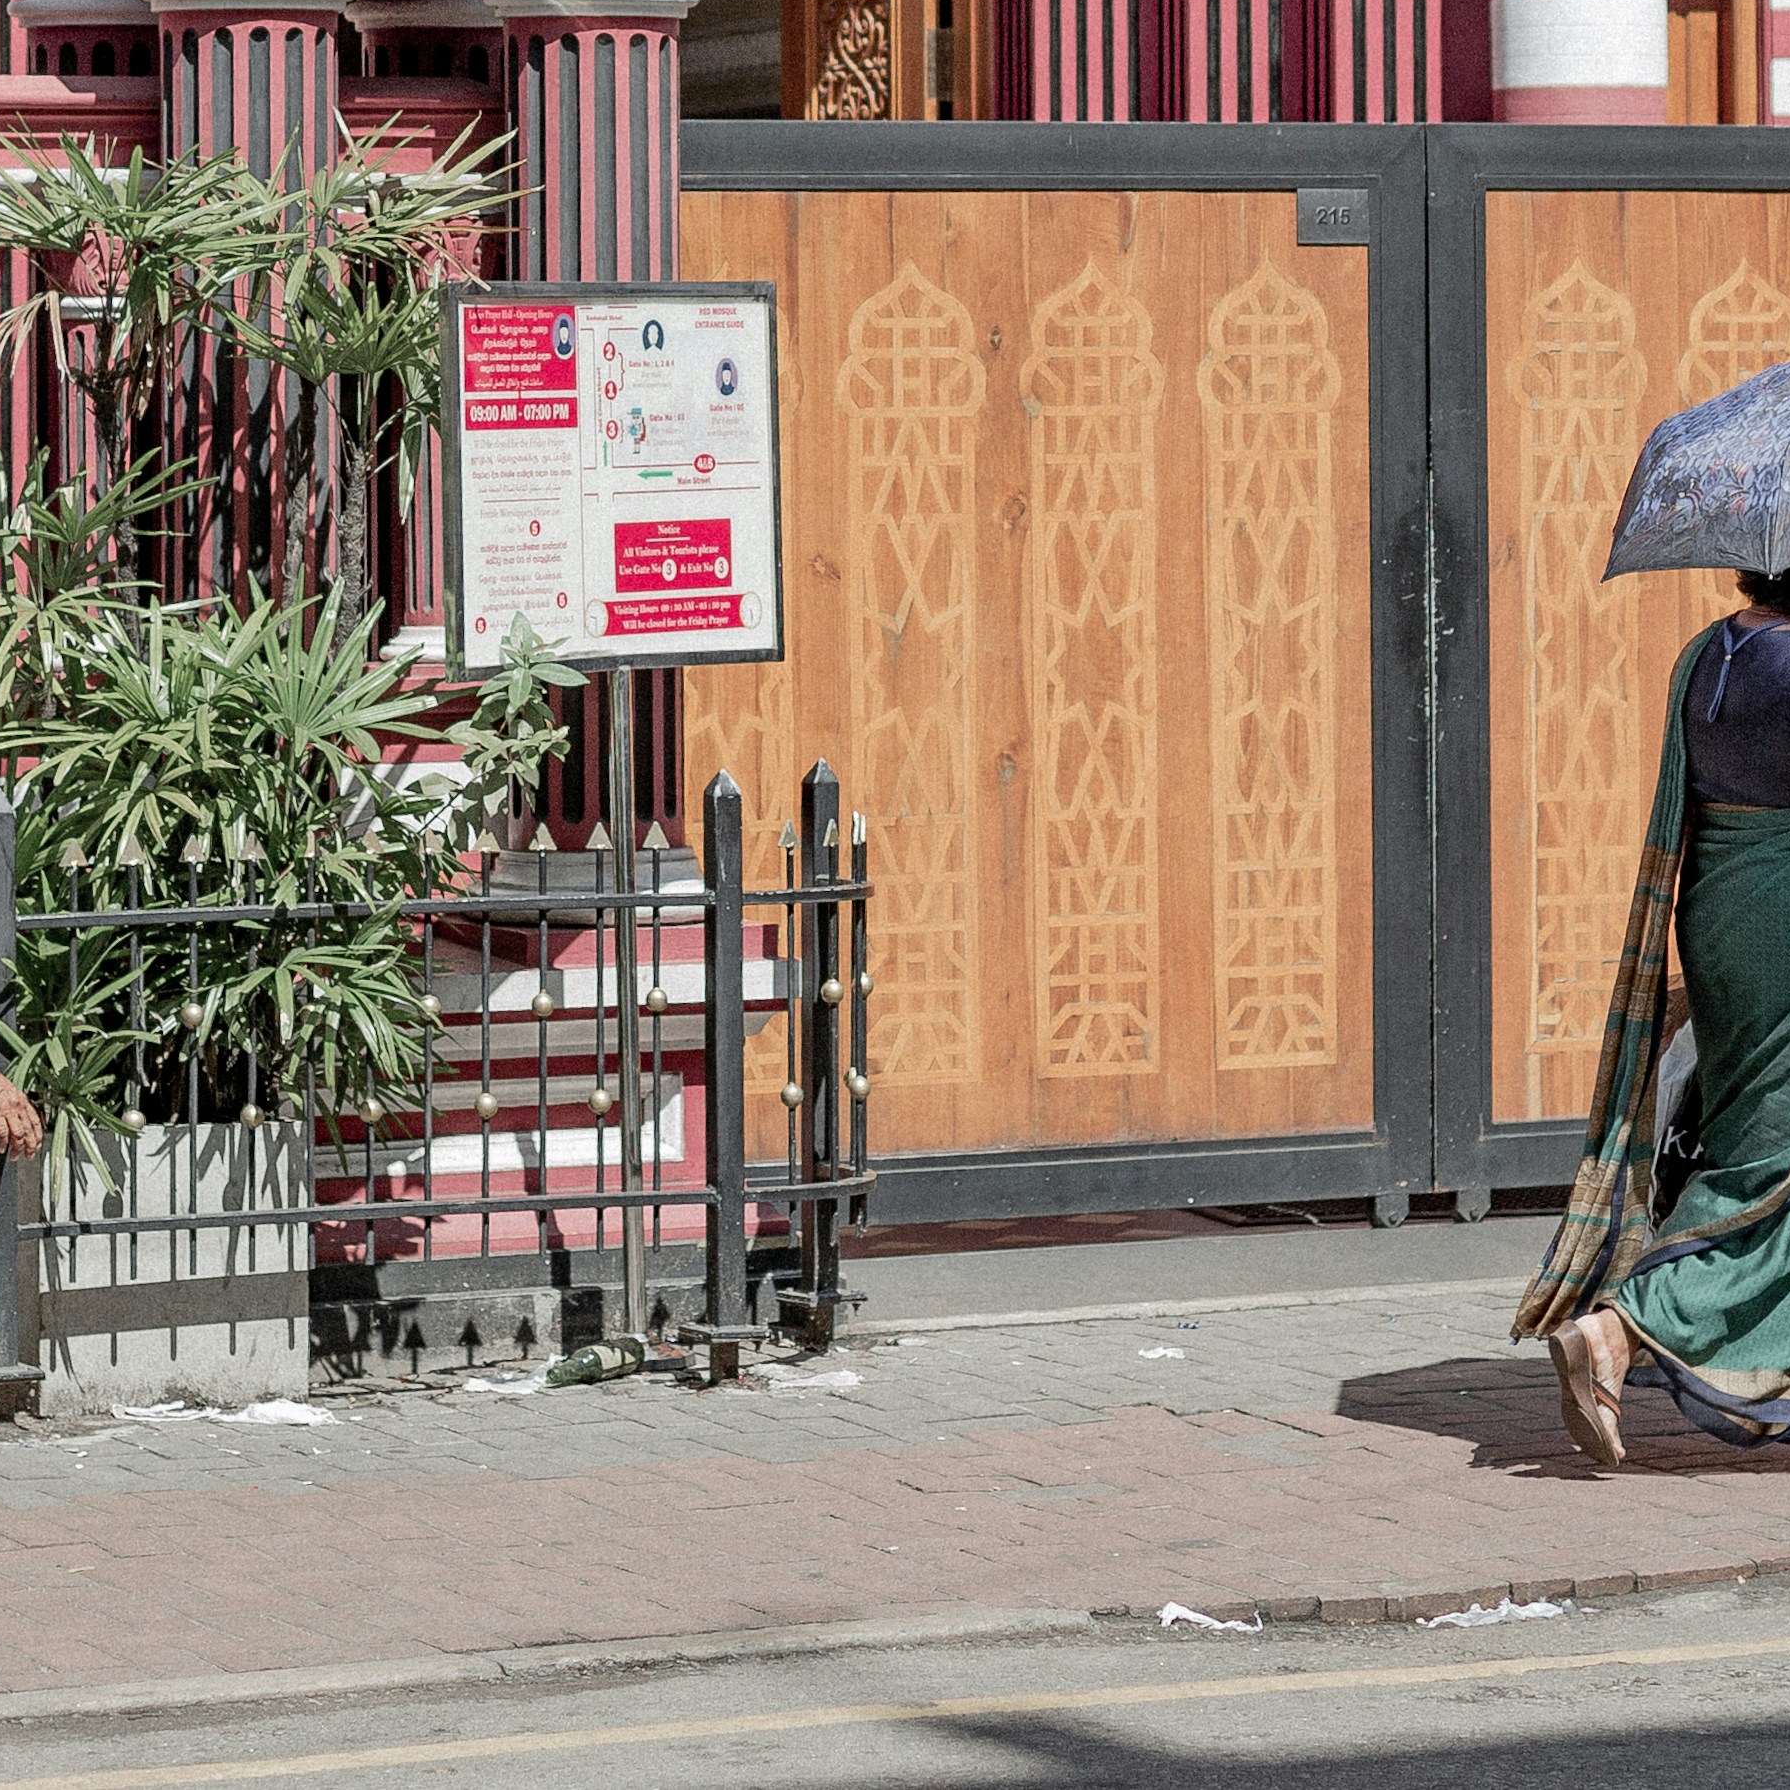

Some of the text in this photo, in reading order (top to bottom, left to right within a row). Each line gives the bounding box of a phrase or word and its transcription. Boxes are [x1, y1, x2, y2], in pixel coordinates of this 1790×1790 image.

[1316, 205, 1351, 226] 215
[699, 308, 737, 316] RED MOSQUE
[695, 321, 745, 329] ENTRANCE GUIDE
[470, 405, 499, 422] 09:00
[501, 404, 517, 421] AM
[524, 404, 551, 420] 07:00
[553, 403, 569, 420] PM
[677, 476, 711, 485] Main Street
[658, 524, 681, 535] Notice
[623, 544, 720, 558] All Visitors & Tourists please
[619, 565, 632, 576] Use
[633, 564, 650, 575] Gate
[650, 564, 662, 574] No
[680, 564, 686, 573] &
[687, 563, 703, 573] Exit
[703, 562, 714, 572] No
[614, 604, 639, 617] Visiting
[639, 604, 659, 615] Hours
[683, 602, 695, 612] AM
[721, 602, 731, 612] pm
[622, 615, 729, 630] Will be closed for the Friday Prayer
